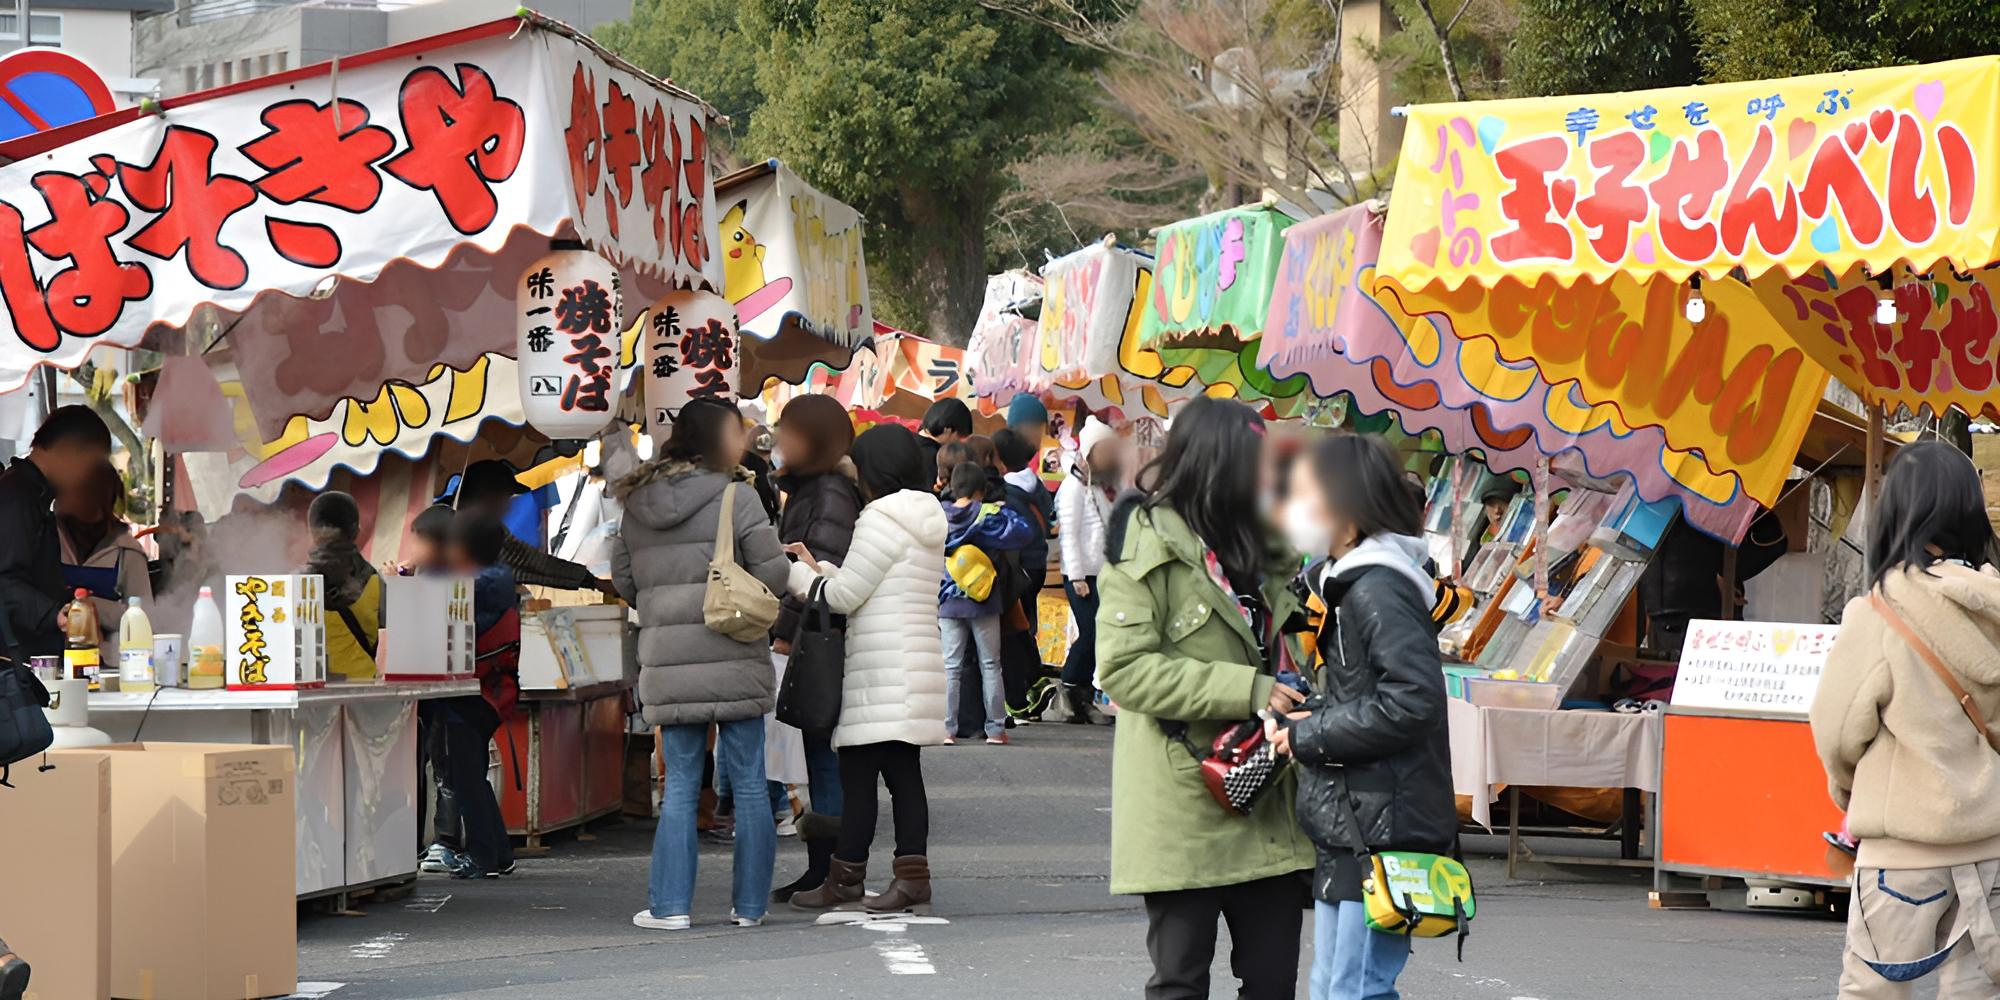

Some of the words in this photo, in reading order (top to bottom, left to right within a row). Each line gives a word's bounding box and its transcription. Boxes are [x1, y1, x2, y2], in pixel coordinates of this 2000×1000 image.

[1565, 88, 1854, 147] 幸せを呼ぶ
[1490, 109, 1976, 263] 玉子せんべい
[526, 267, 554, 353] 味一番
[554, 278, 613, 412] 焼そば
[652, 305, 683, 378] 味一番
[1834, 282, 2000, 394] 玉子せ
[679, 318, 734, 401] 焼そ
